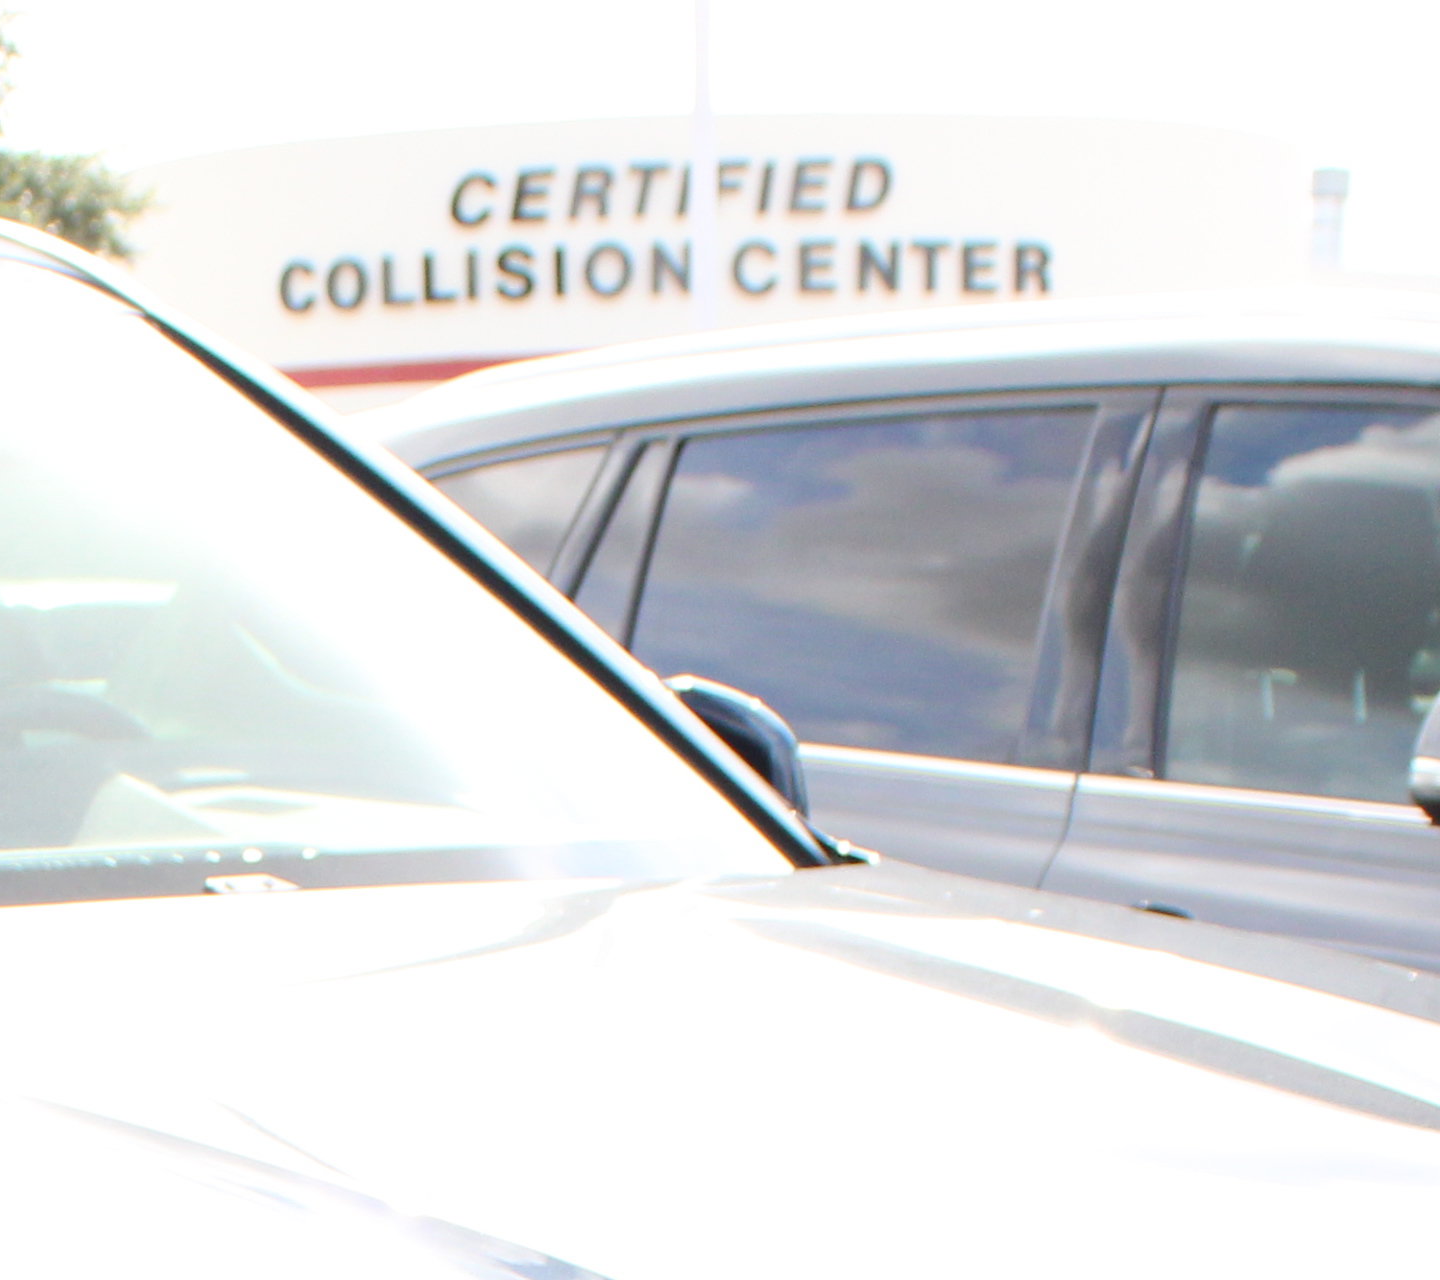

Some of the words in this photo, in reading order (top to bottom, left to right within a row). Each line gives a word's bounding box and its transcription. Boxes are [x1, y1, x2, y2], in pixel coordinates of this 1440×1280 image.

[448, 155, 895, 228] CERTIFIED
[278, 240, 693, 316] COLLISION
[731, 238, 1054, 299] CENTER
